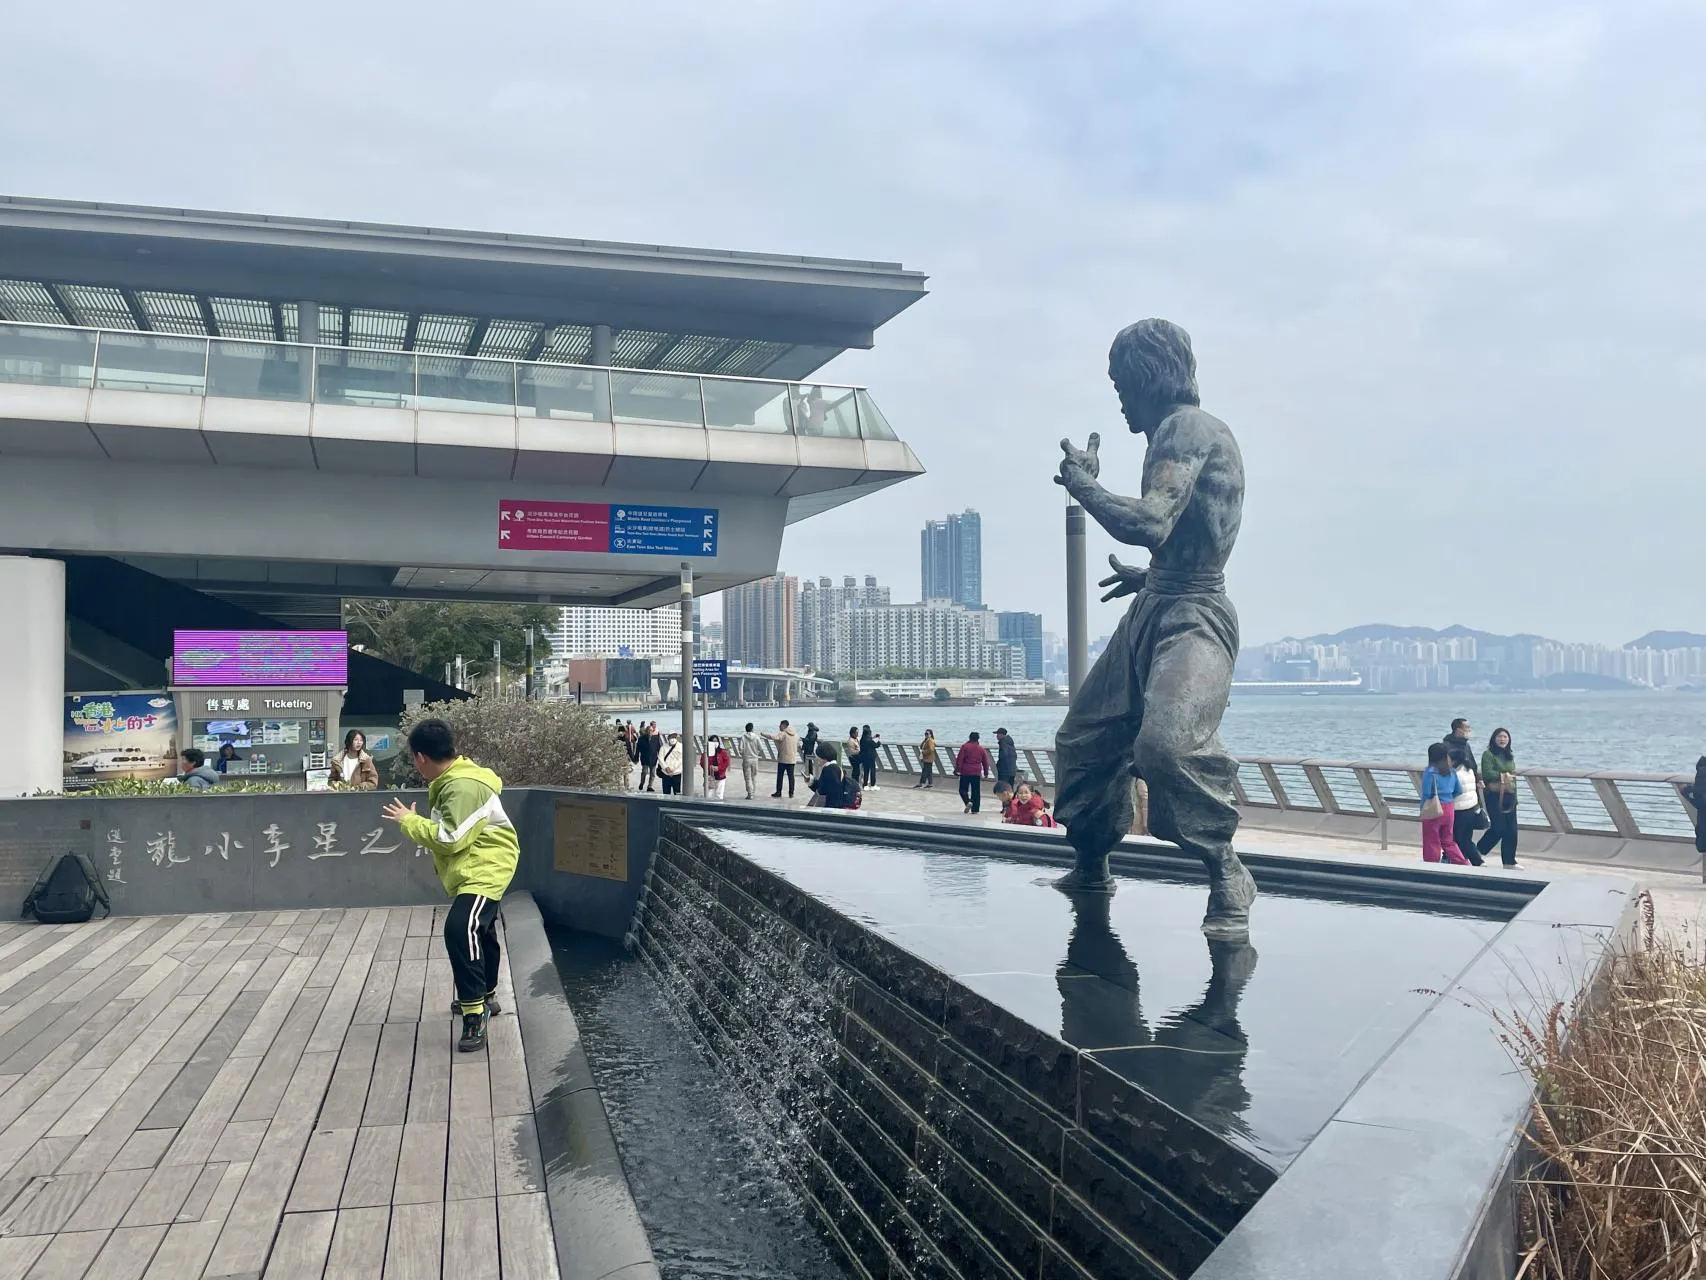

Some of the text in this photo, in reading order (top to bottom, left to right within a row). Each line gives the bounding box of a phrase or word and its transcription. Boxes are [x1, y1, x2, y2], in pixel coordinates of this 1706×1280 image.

[711, 677, 721, 689] B
[206, 698, 250, 711] 售票處
[264, 699, 313, 710] Ticketing
